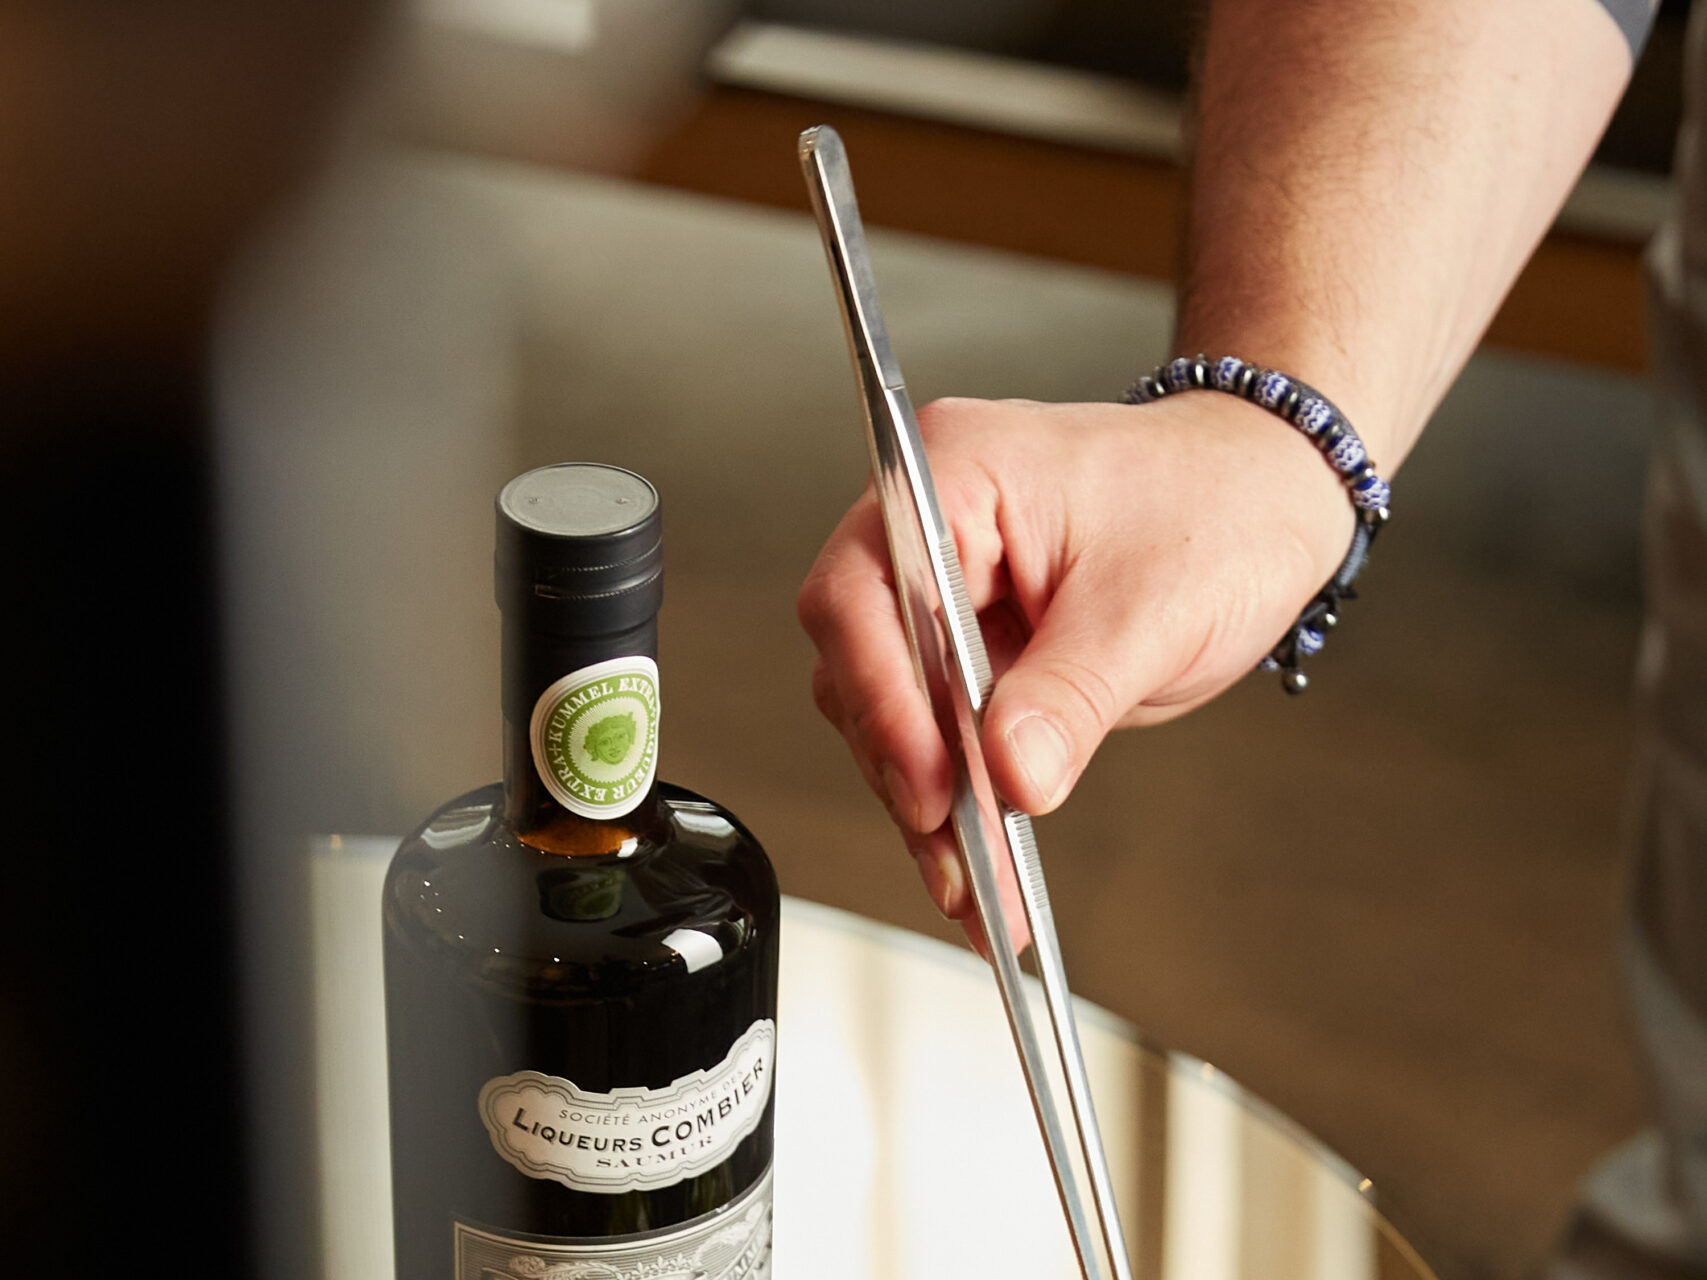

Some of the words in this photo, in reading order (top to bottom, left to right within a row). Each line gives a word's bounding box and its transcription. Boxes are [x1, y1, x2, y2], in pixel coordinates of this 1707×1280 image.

[549, 682, 613, 741] KUMMEL
[555, 756, 608, 801] EXTRA
[512, 1107, 642, 1152] LIQUEURS
[651, 1057, 766, 1148] COMBIER
[559, 1108, 630, 1126] SOCIÉTÉ
[638, 1090, 719, 1125] ANONYME
[721, 1070, 745, 1092] DES
[595, 1136, 712, 1168] SAUMUR
